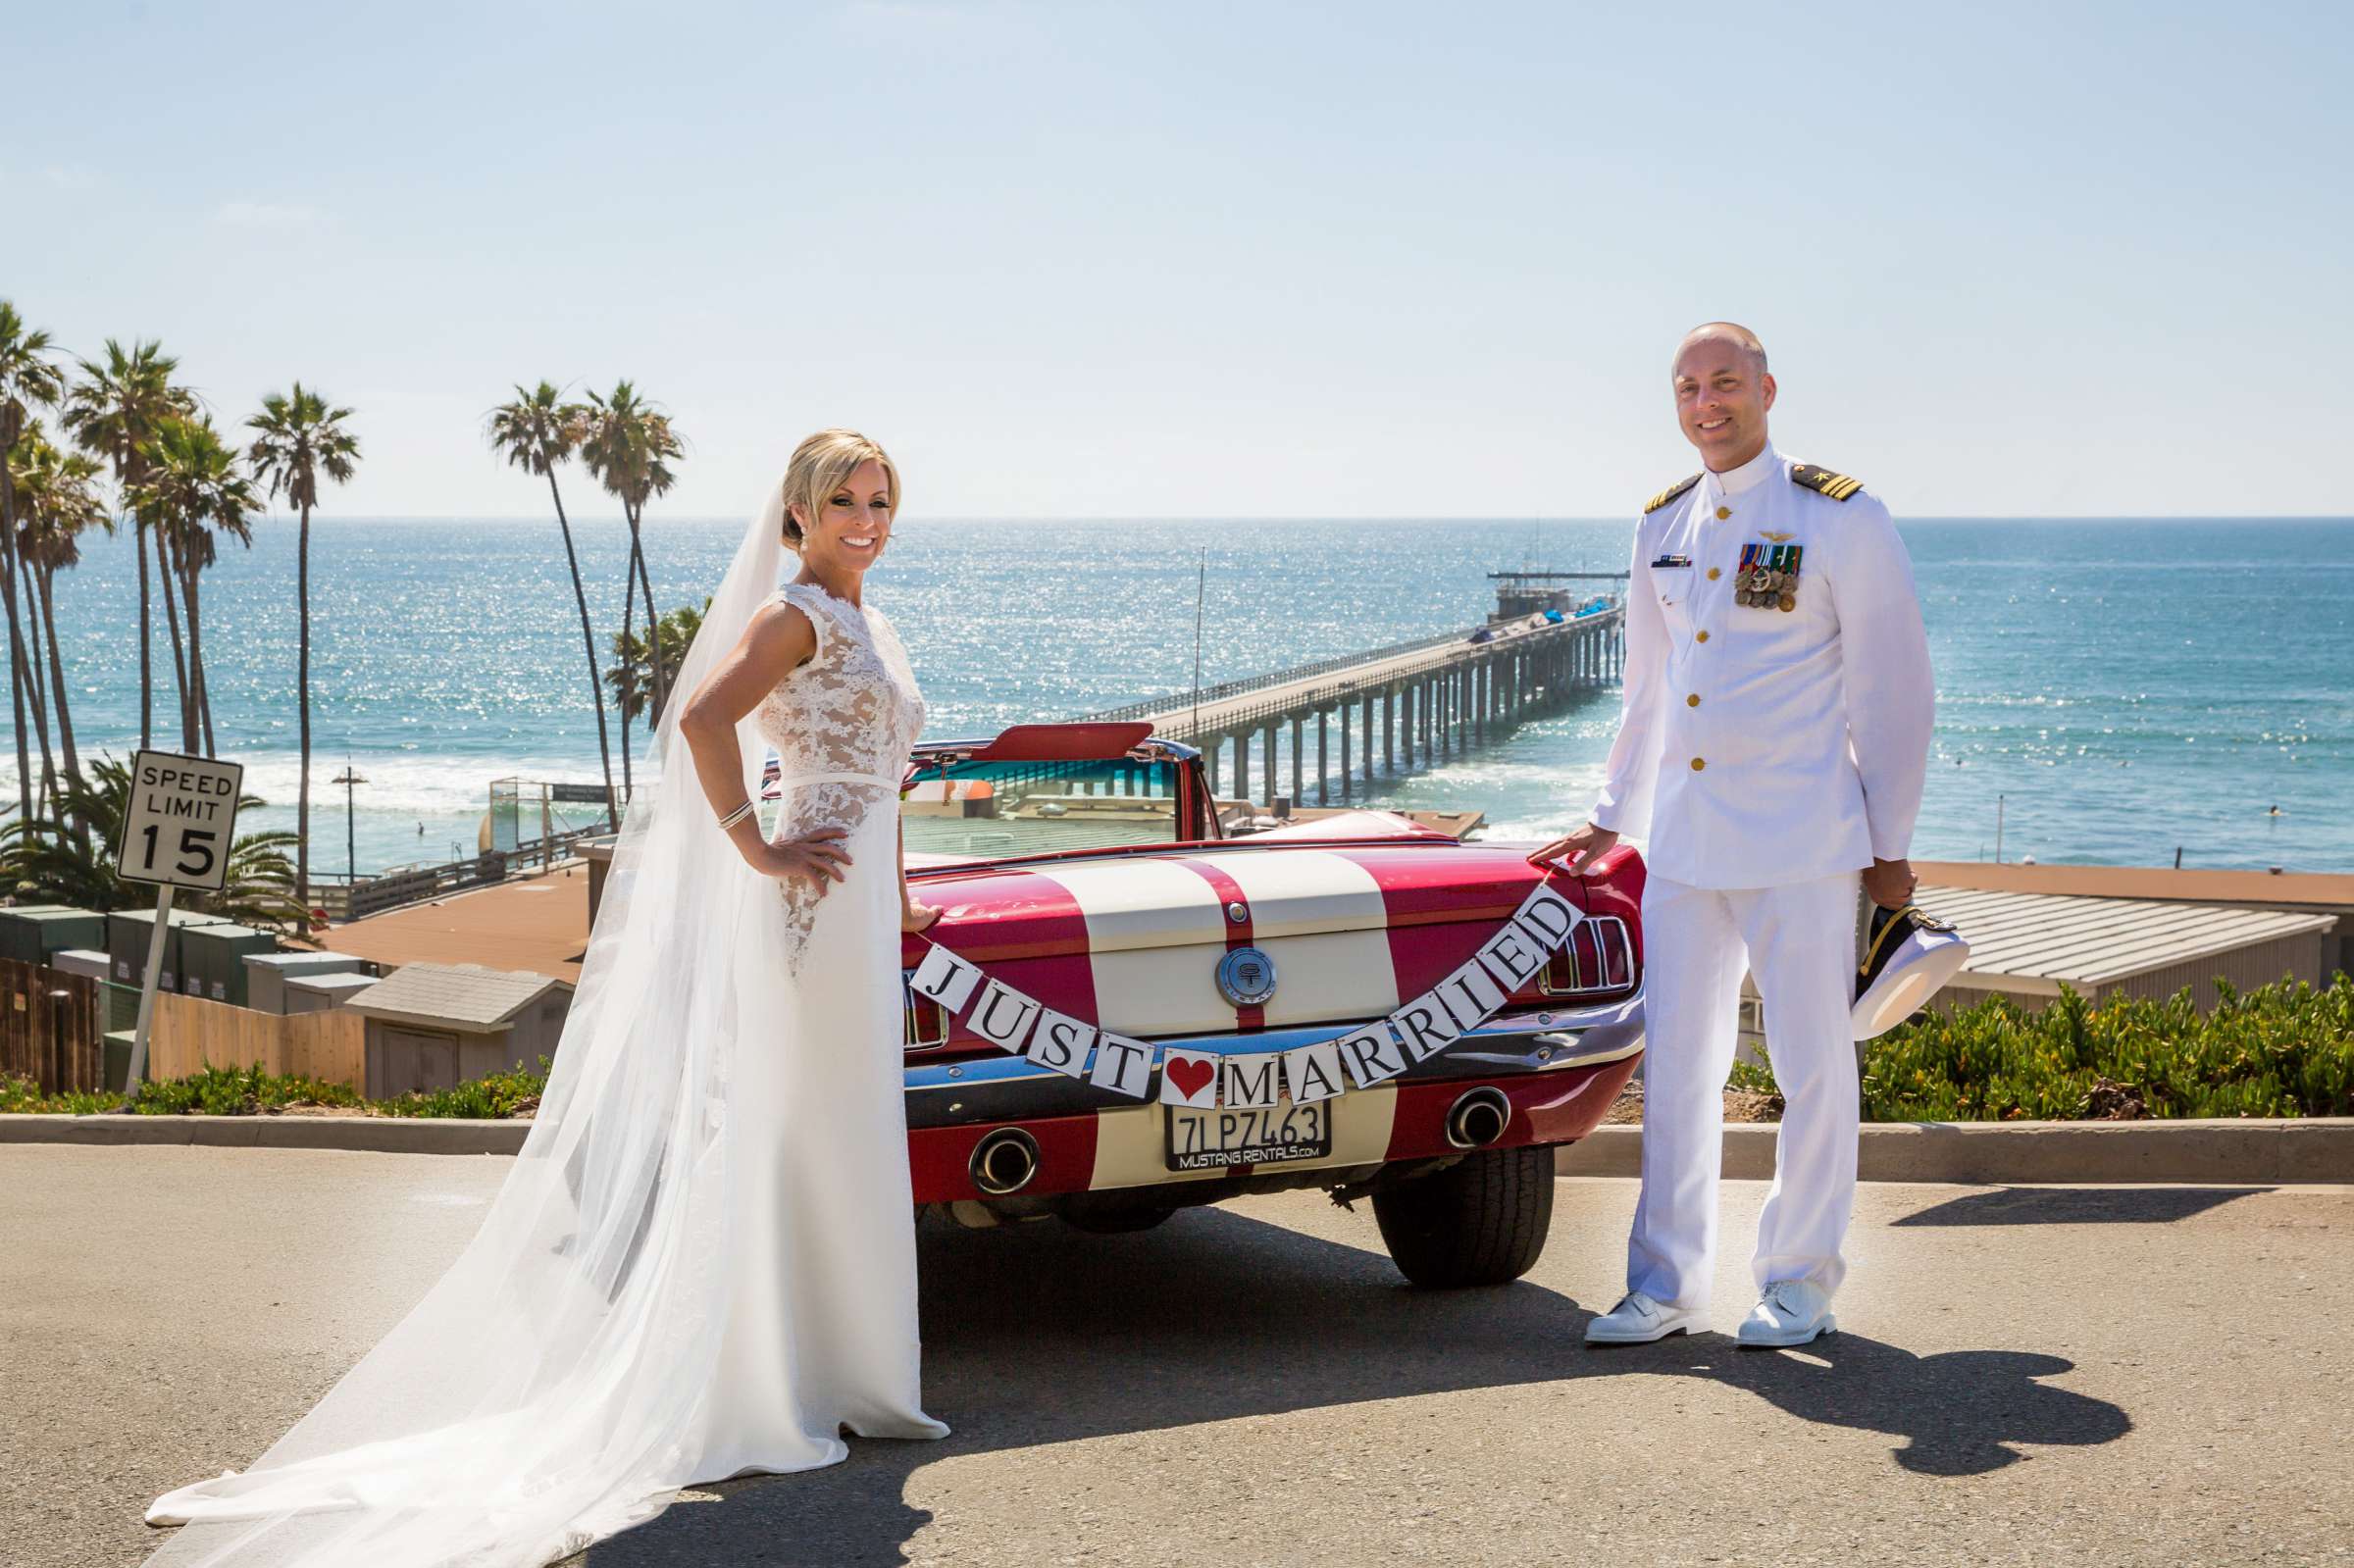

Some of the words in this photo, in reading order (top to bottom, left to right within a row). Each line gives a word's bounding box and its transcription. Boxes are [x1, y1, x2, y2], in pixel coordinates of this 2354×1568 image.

[142, 767, 232, 796] SPEED
[147, 793, 220, 821] LIMIT
[143, 825, 216, 877] 15
[925, 959, 1145, 1091] JUST
[1228, 895, 1572, 1107] MARRIED
[1178, 1105, 1319, 1154] 7LPZ463
[1179, 1151, 1242, 1169] MUSTANG
[1243, 1144, 1319, 1163] RENTALS.COM
